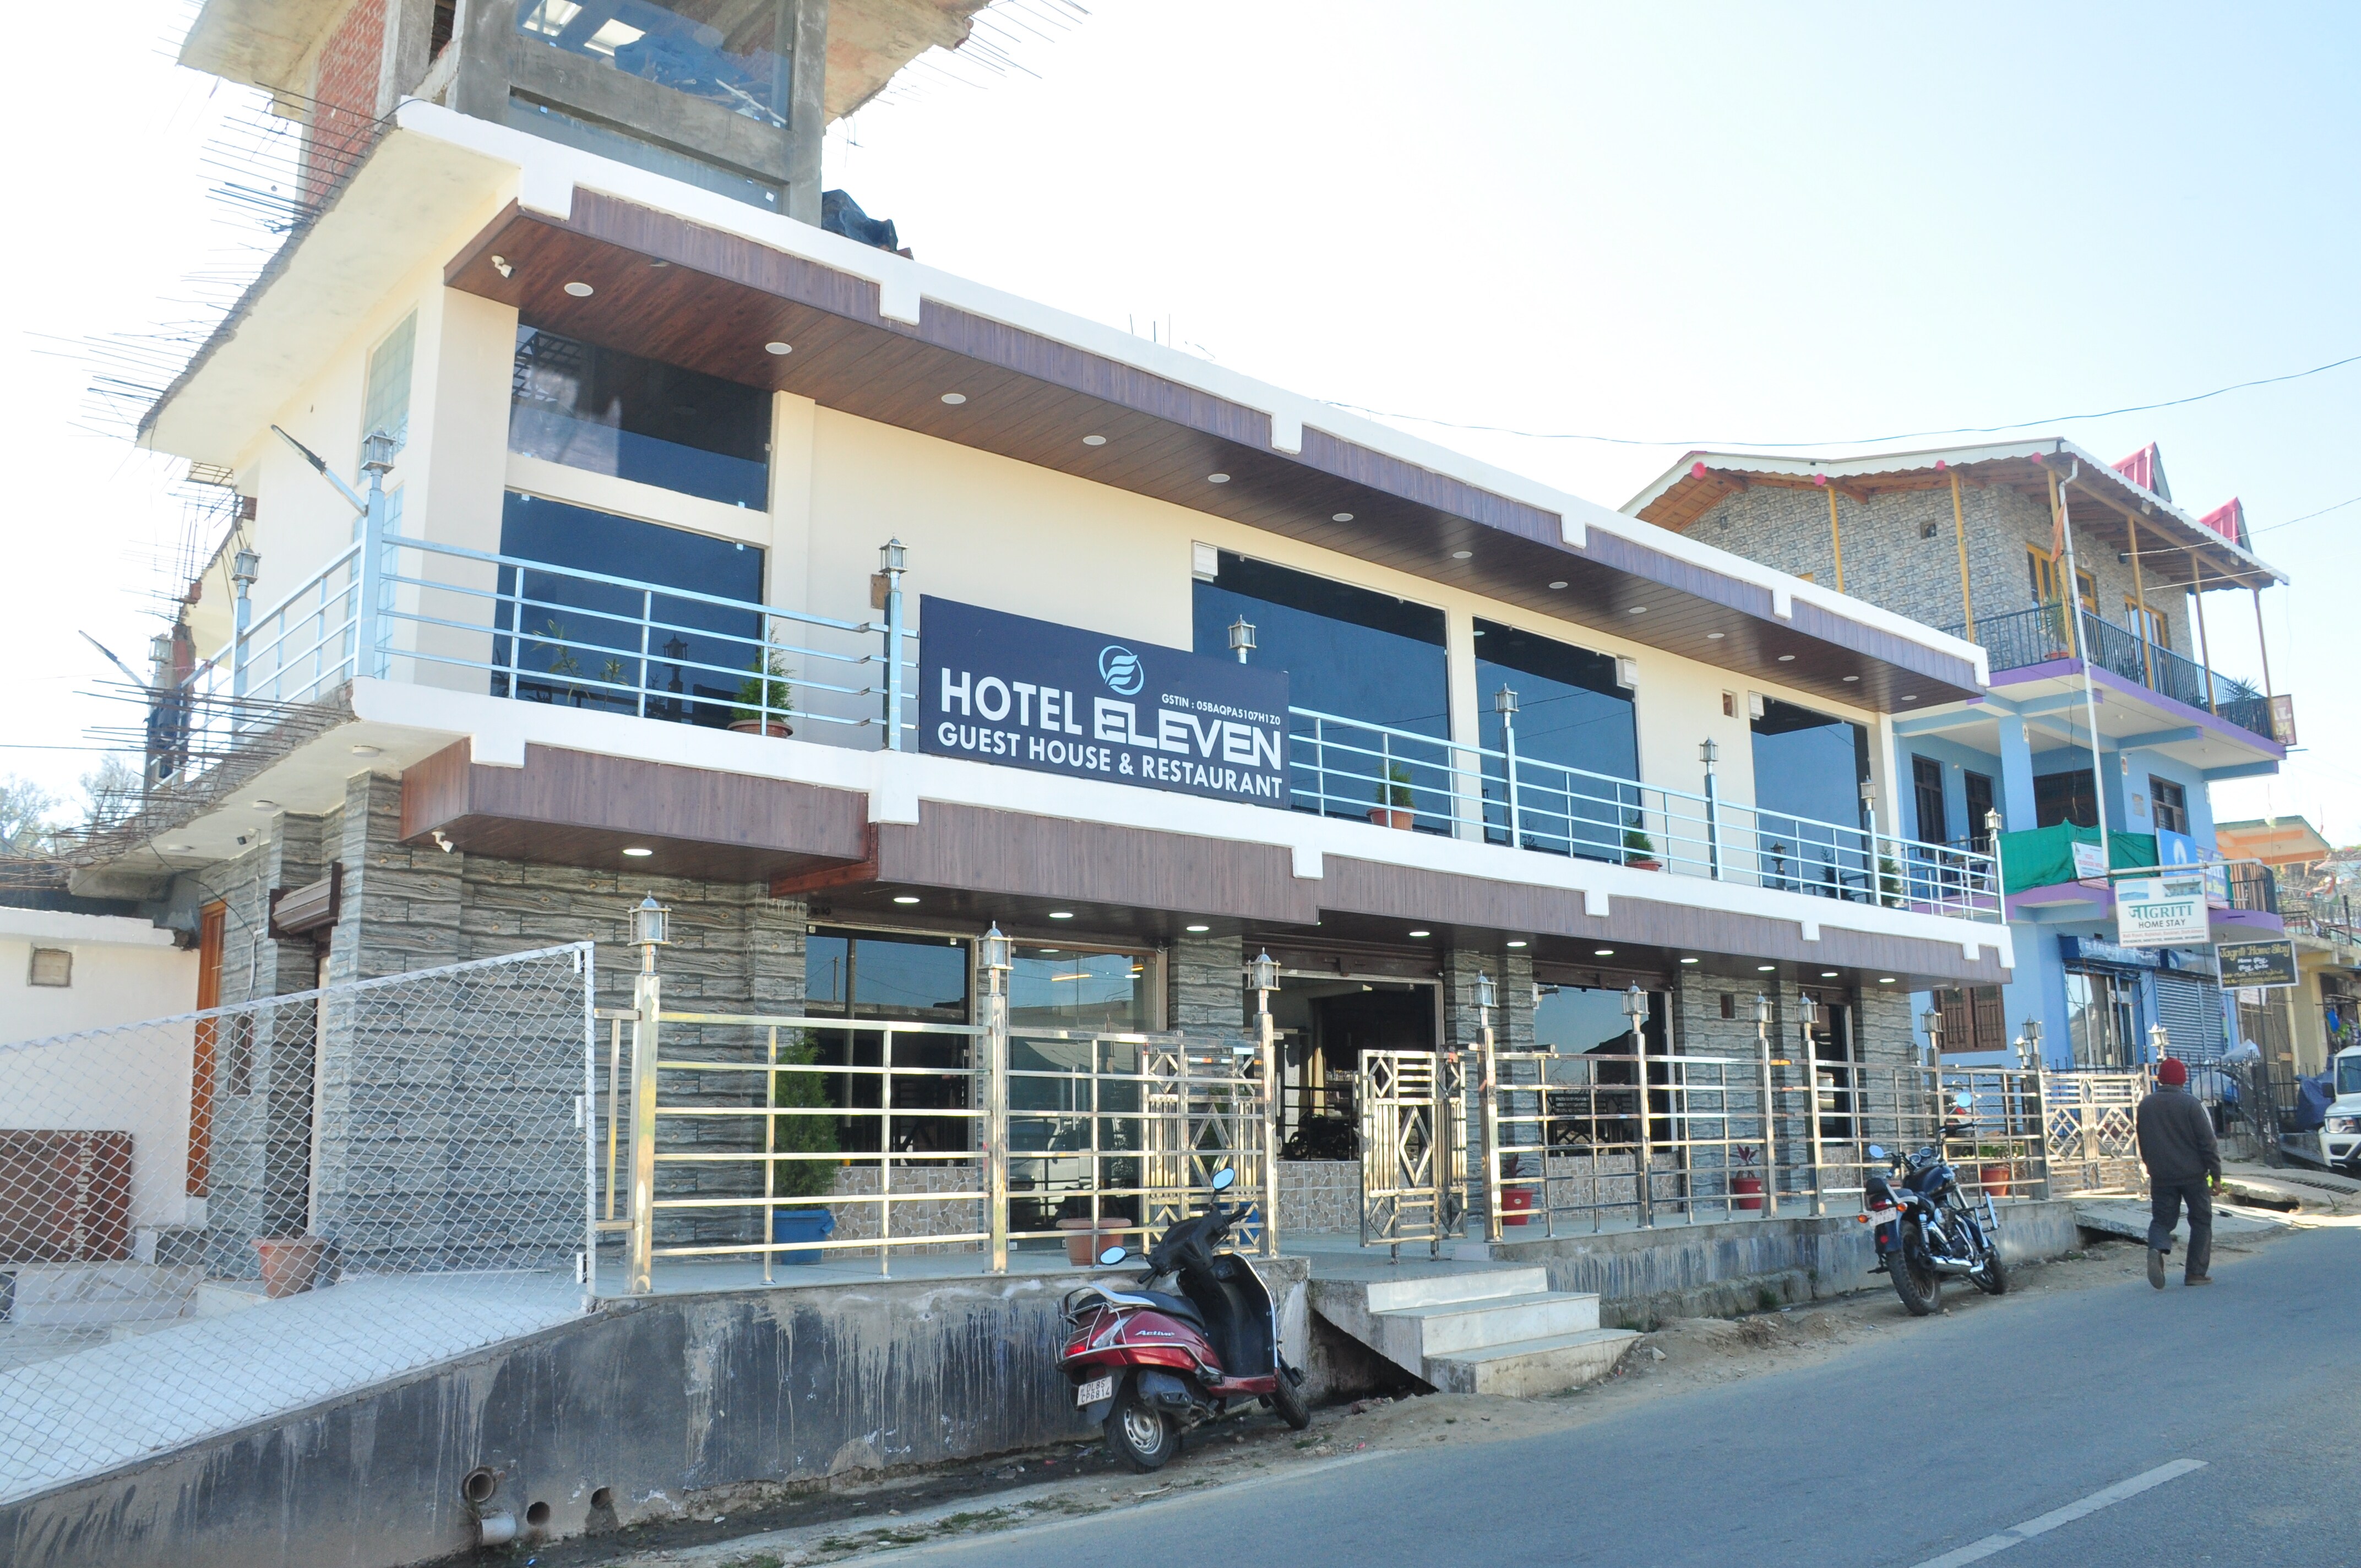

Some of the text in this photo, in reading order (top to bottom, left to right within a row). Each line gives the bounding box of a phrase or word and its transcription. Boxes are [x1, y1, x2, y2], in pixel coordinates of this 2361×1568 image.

[1161, 693, 1189, 709] GSTIN
[941, 667, 1281, 771] HOTEL ELEVEN
[938, 721, 1282, 799] GUEST HOUSE & RESTAURANT
[2138, 918, 2186, 929] HOME STAY
[2219, 947, 2245, 961] Jagriti
[2246, 945, 2270, 956] Home
[2271, 943, 2291, 957] Stay
[1086, 1379, 1105, 1392] DL8S
[1081, 1386, 1110, 1403] CP6814
